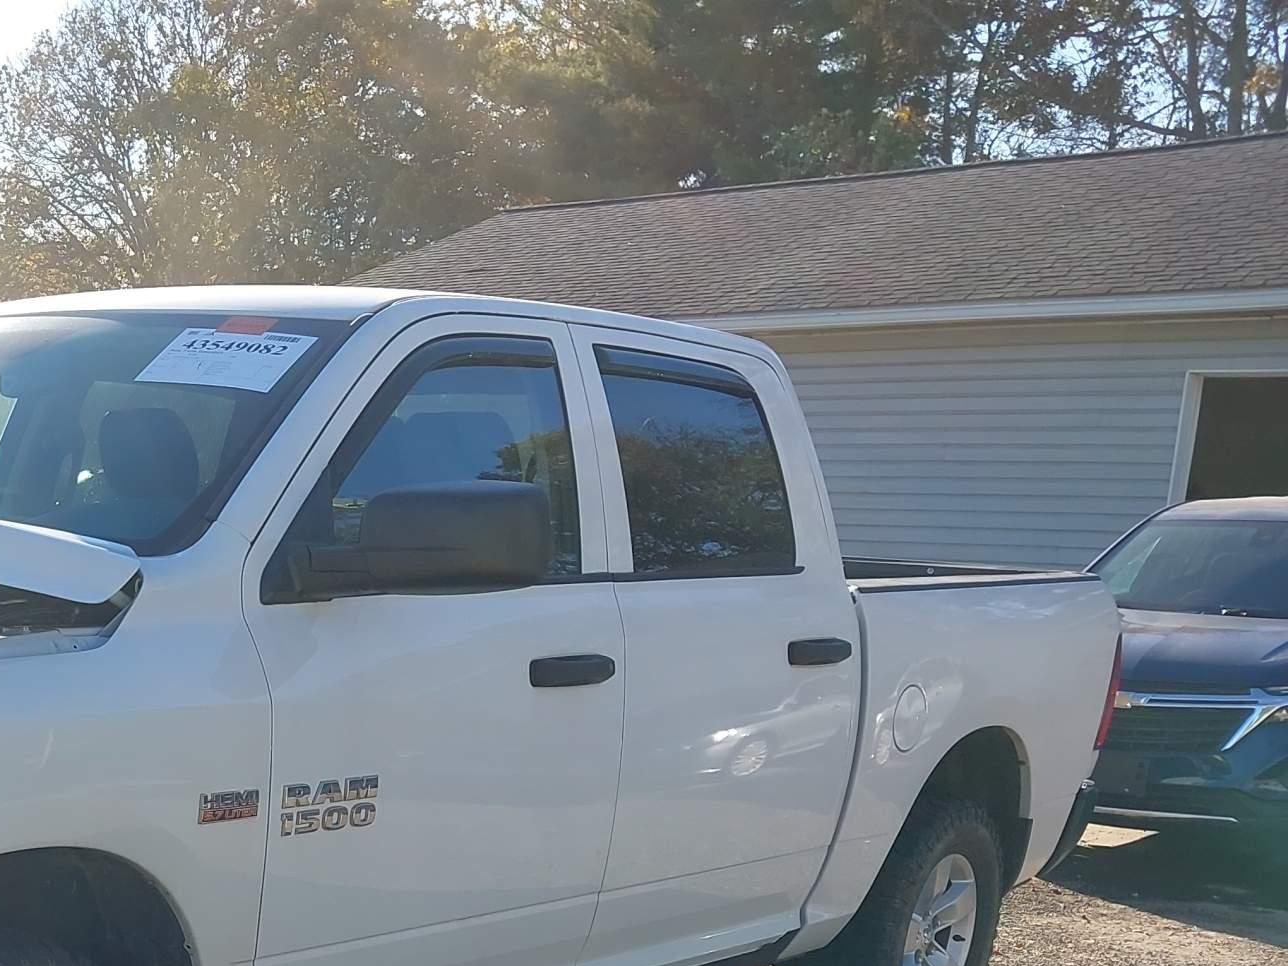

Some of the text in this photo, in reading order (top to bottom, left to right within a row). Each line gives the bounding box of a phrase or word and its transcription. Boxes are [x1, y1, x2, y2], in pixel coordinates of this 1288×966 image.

[182, 338, 289, 356] 43549082
[199, 789, 260, 809] HEMI
[281, 774, 379, 809] RAM
[280, 802, 377, 837] 1500
